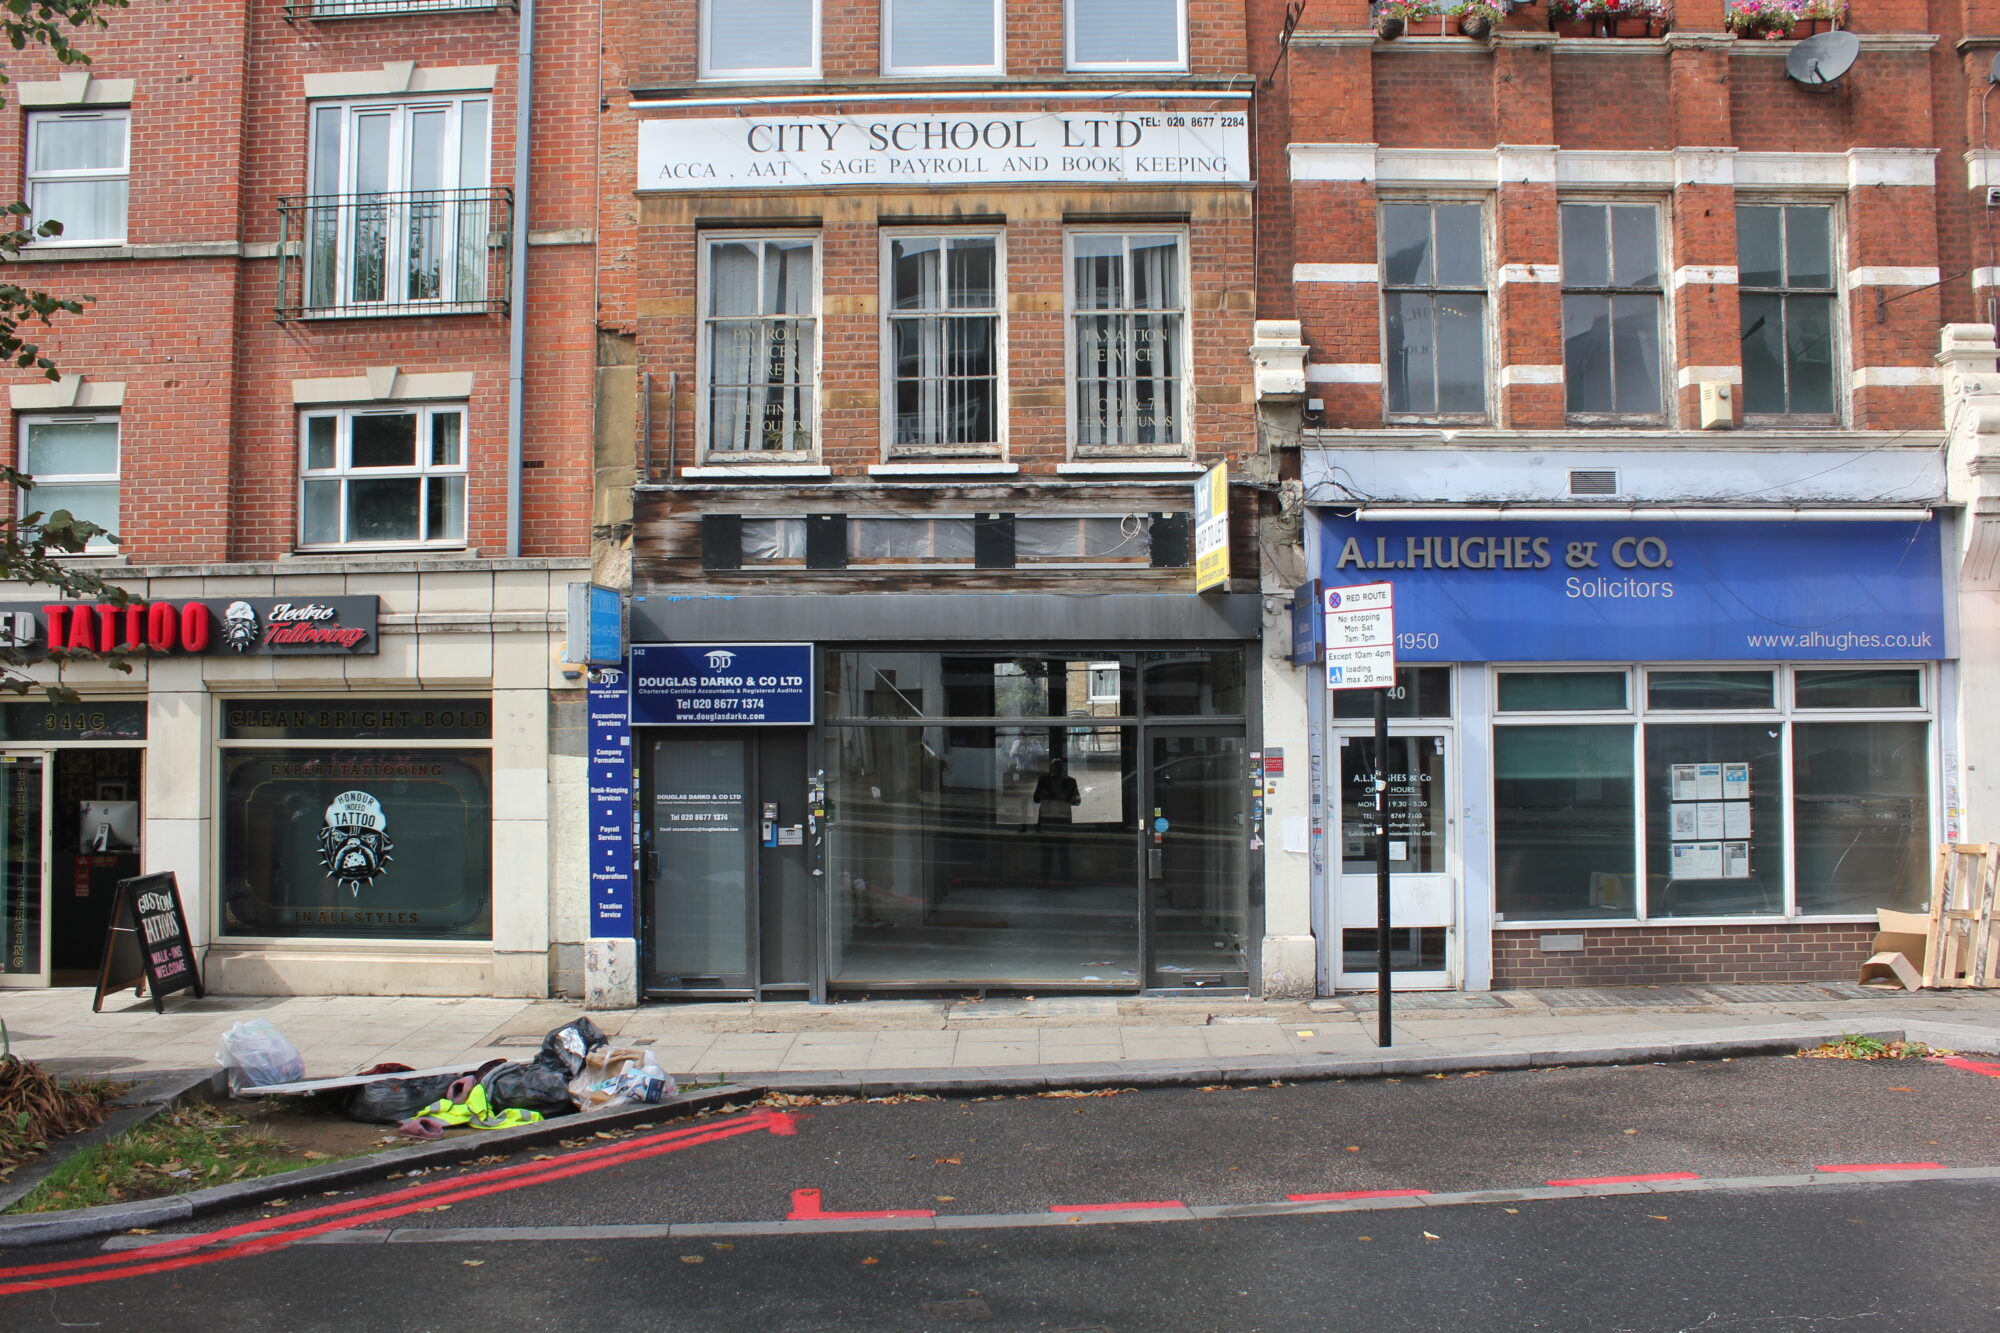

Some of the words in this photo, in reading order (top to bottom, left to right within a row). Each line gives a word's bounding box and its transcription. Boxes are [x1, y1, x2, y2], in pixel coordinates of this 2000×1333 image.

[1139, 117, 1161, 128] TEL:
[1167, 117, 1185, 127] 020
[1191, 117, 1215, 127] 8677
[1221, 117, 1245, 127] 2284
[747, 123, 847, 152] CITY
[869, 120, 1037, 151] SCHOOL
[1062, 119, 1141, 148] LTD
[658, 163, 717, 179] ACCA
[747, 161, 791, 177] AAT
[820, 159, 877, 175] SAGE
[890, 157, 990, 174] PAYROLL
[1002, 156, 1049, 172] AND
[1062, 156, 1121, 172] BOOK
[1136, 156, 1229, 173] KEEPING
[1335, 536, 1552, 569] A.L.HUGHES
[1565, 541, 1599, 568] &
[1610, 536, 1675, 568] CO.
[1565, 576, 1675, 599] Solicitors
[1346, 593, 1361, 602] RED
[1362, 591, 1387, 601] ROUTE
[267, 603, 334, 622] Electric
[1350, 612, 1381, 623] stopping
[42, 601, 210, 653] TATTOO
[262, 621, 368, 648] Tattooing
[1396, 632, 1439, 650] 1950
[1747, 631, 1933, 652] www.alhughes.co.uk
[1328, 652, 1352, 662] Except
[1346, 665, 1372, 674] loading
[638, 677, 698, 687] DOUGLAS
[700, 677, 743, 687] DARKO
[746, 676, 756, 686] &
[758, 676, 777, 686] CO
[780, 676, 803, 686] LTD
[1364, 674, 1374, 682] 20
[1376, 673, 1393, 682] mins
[676, 698, 691, 709] Tel
[693, 698, 712, 709] 020
[714, 698, 739, 709] 8677
[741, 698, 765, 709] 1374
[45, 712, 105, 731] 344C
[229, 710, 306, 729] CLEAN
[318, 710, 411, 729] BRIGHT
[423, 710, 489, 729] BOLD
[676, 712, 766, 721] www.douglasdarko.com
[596, 749, 623, 757] Company
[271, 764, 334, 777] EXPERT
[340, 764, 443, 777] TATTOOING
[1390, 786, 1416, 794] HOURS
[337, 792, 375, 807] HONOUR
[345, 803, 366, 812] INDEED
[333, 811, 376, 828] TATTOO
[600, 825, 620, 833] Payroll
[138, 890, 175, 914] CUSTOM
[353, 912, 418, 924] STYLES
[142, 911, 181, 944] TATTOOS
[154, 959, 188, 979] WELCOME
